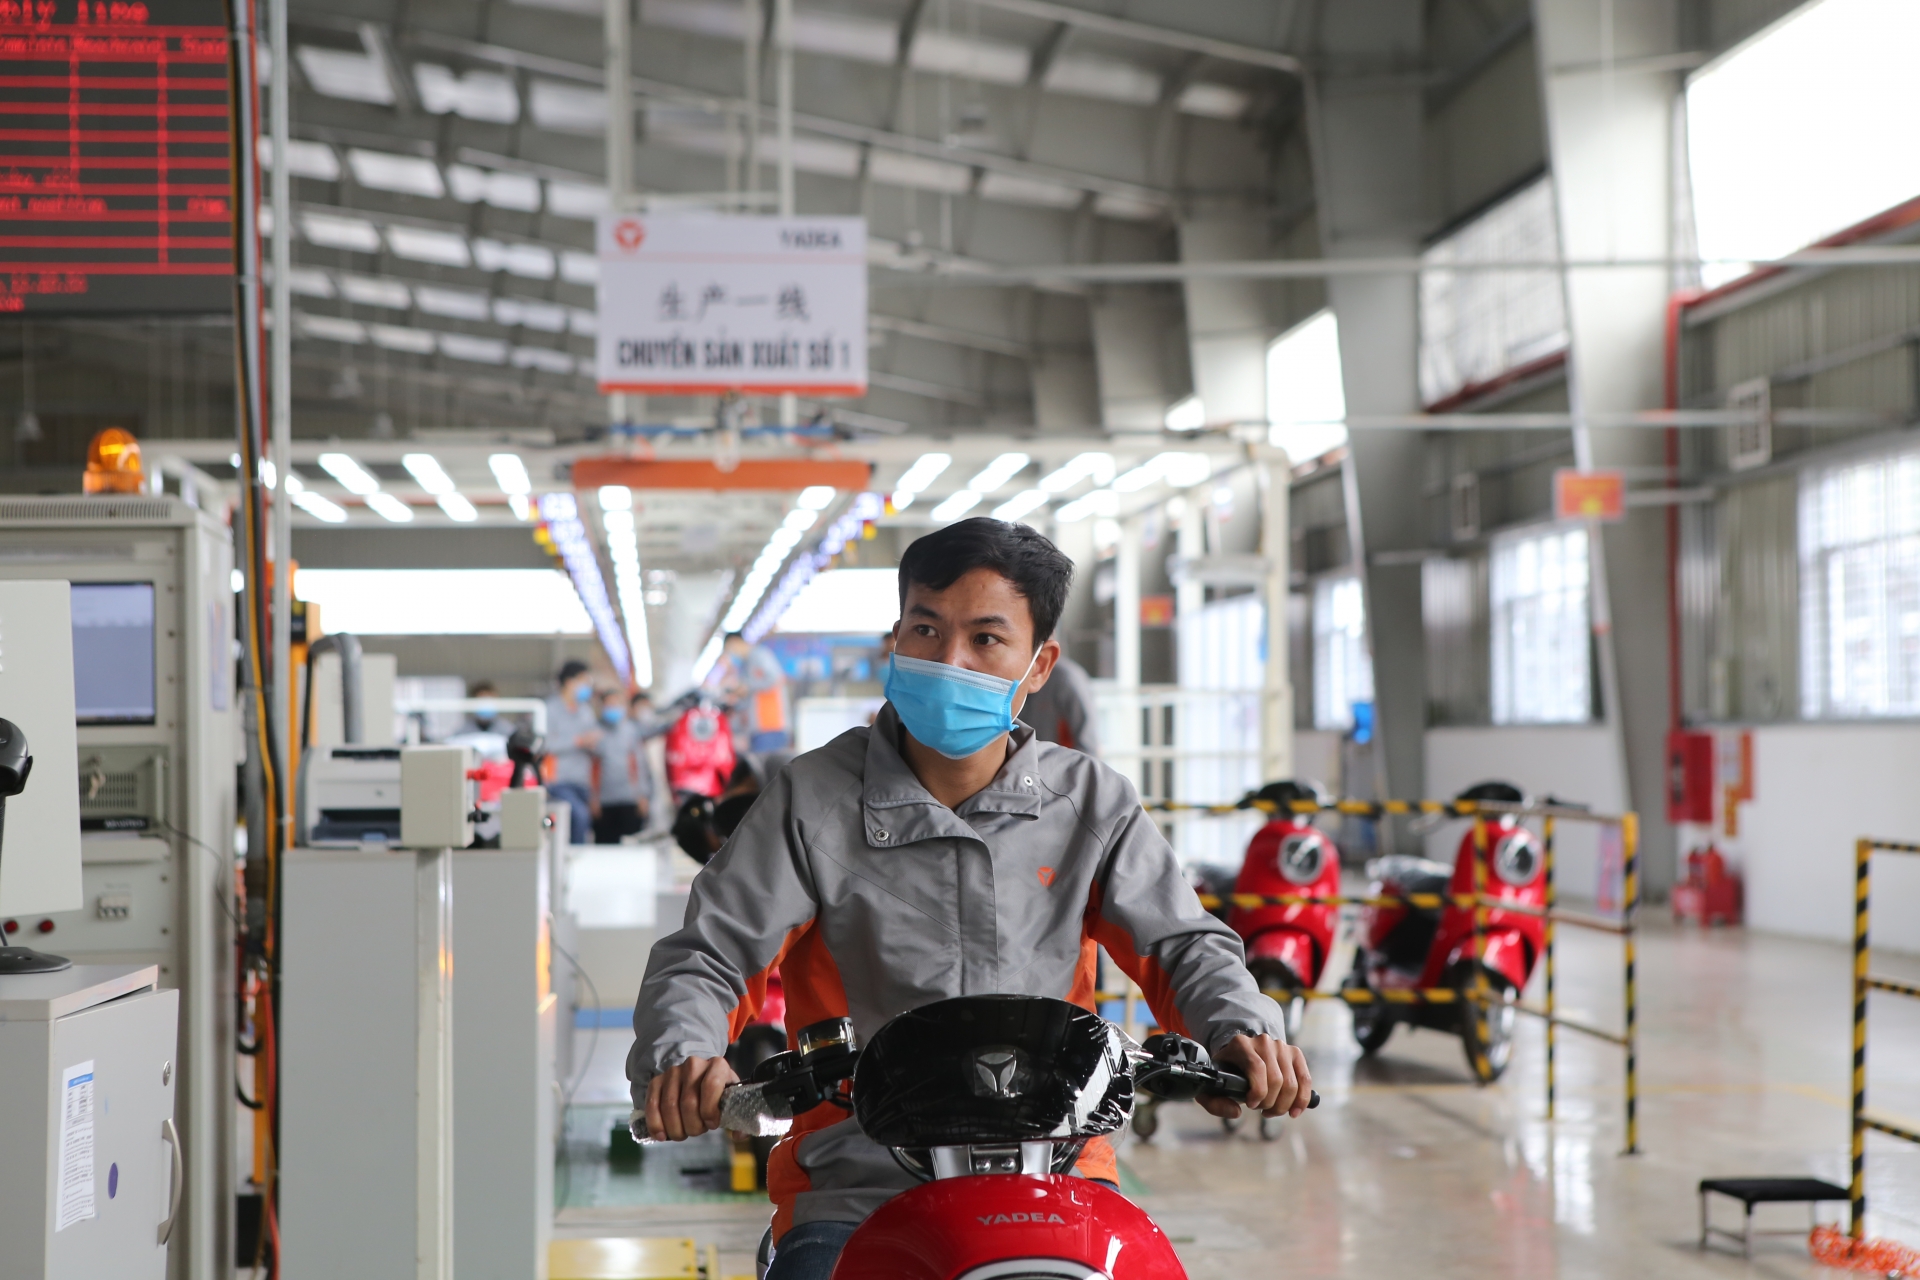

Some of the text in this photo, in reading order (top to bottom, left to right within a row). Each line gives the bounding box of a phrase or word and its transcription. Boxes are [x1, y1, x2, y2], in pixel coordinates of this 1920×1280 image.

[781, 228, 842, 249] YADEA
[841, 340, 850, 369] 1
[976, 1212, 1066, 1226] YADEA
